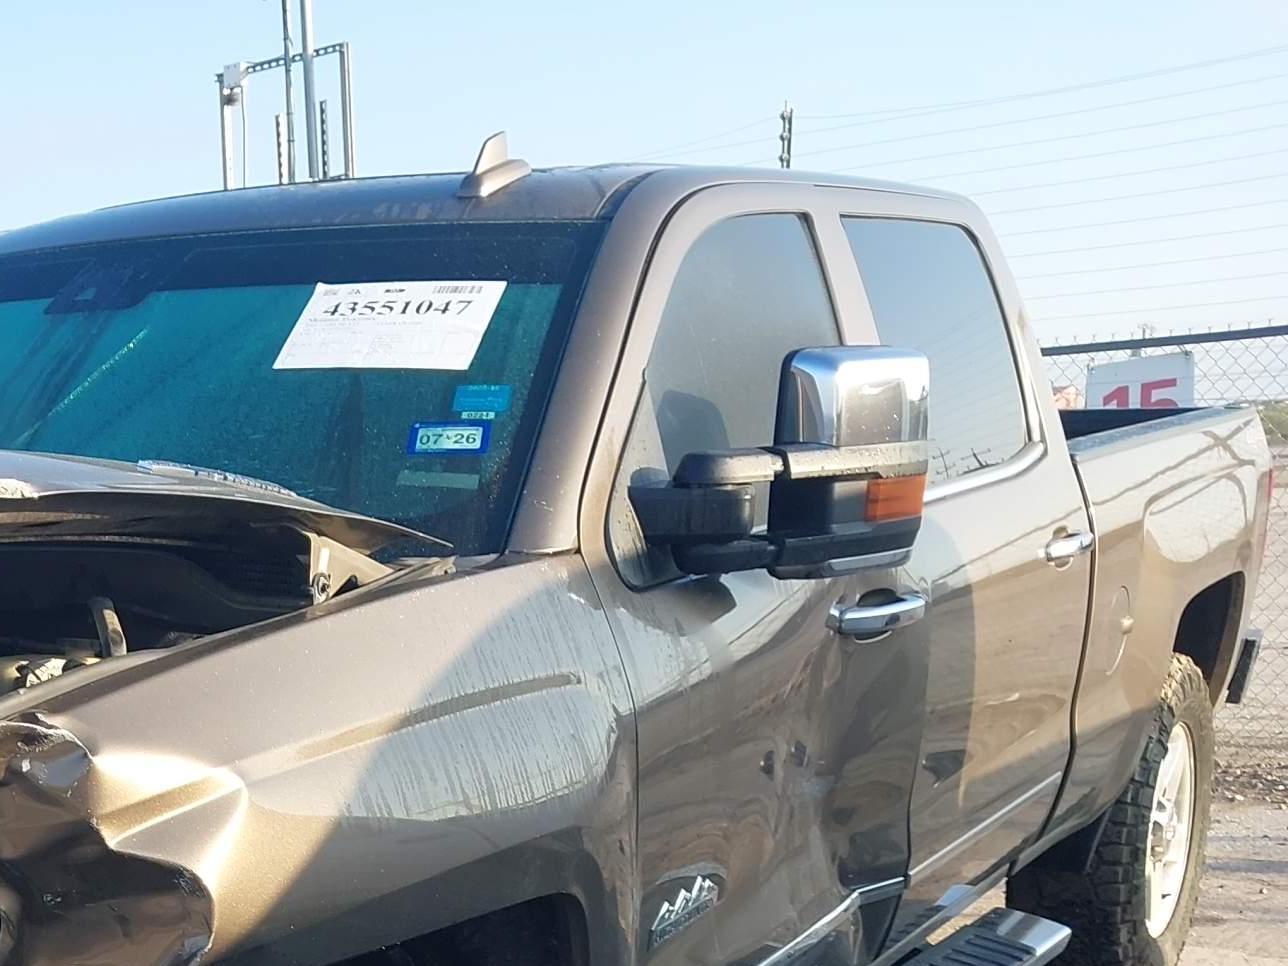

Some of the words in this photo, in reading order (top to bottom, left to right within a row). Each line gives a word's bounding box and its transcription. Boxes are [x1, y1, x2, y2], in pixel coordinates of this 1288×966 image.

[322, 299, 475, 317] 43551047
[419, 433, 444, 446] 07
[453, 432, 478, 445] 26
